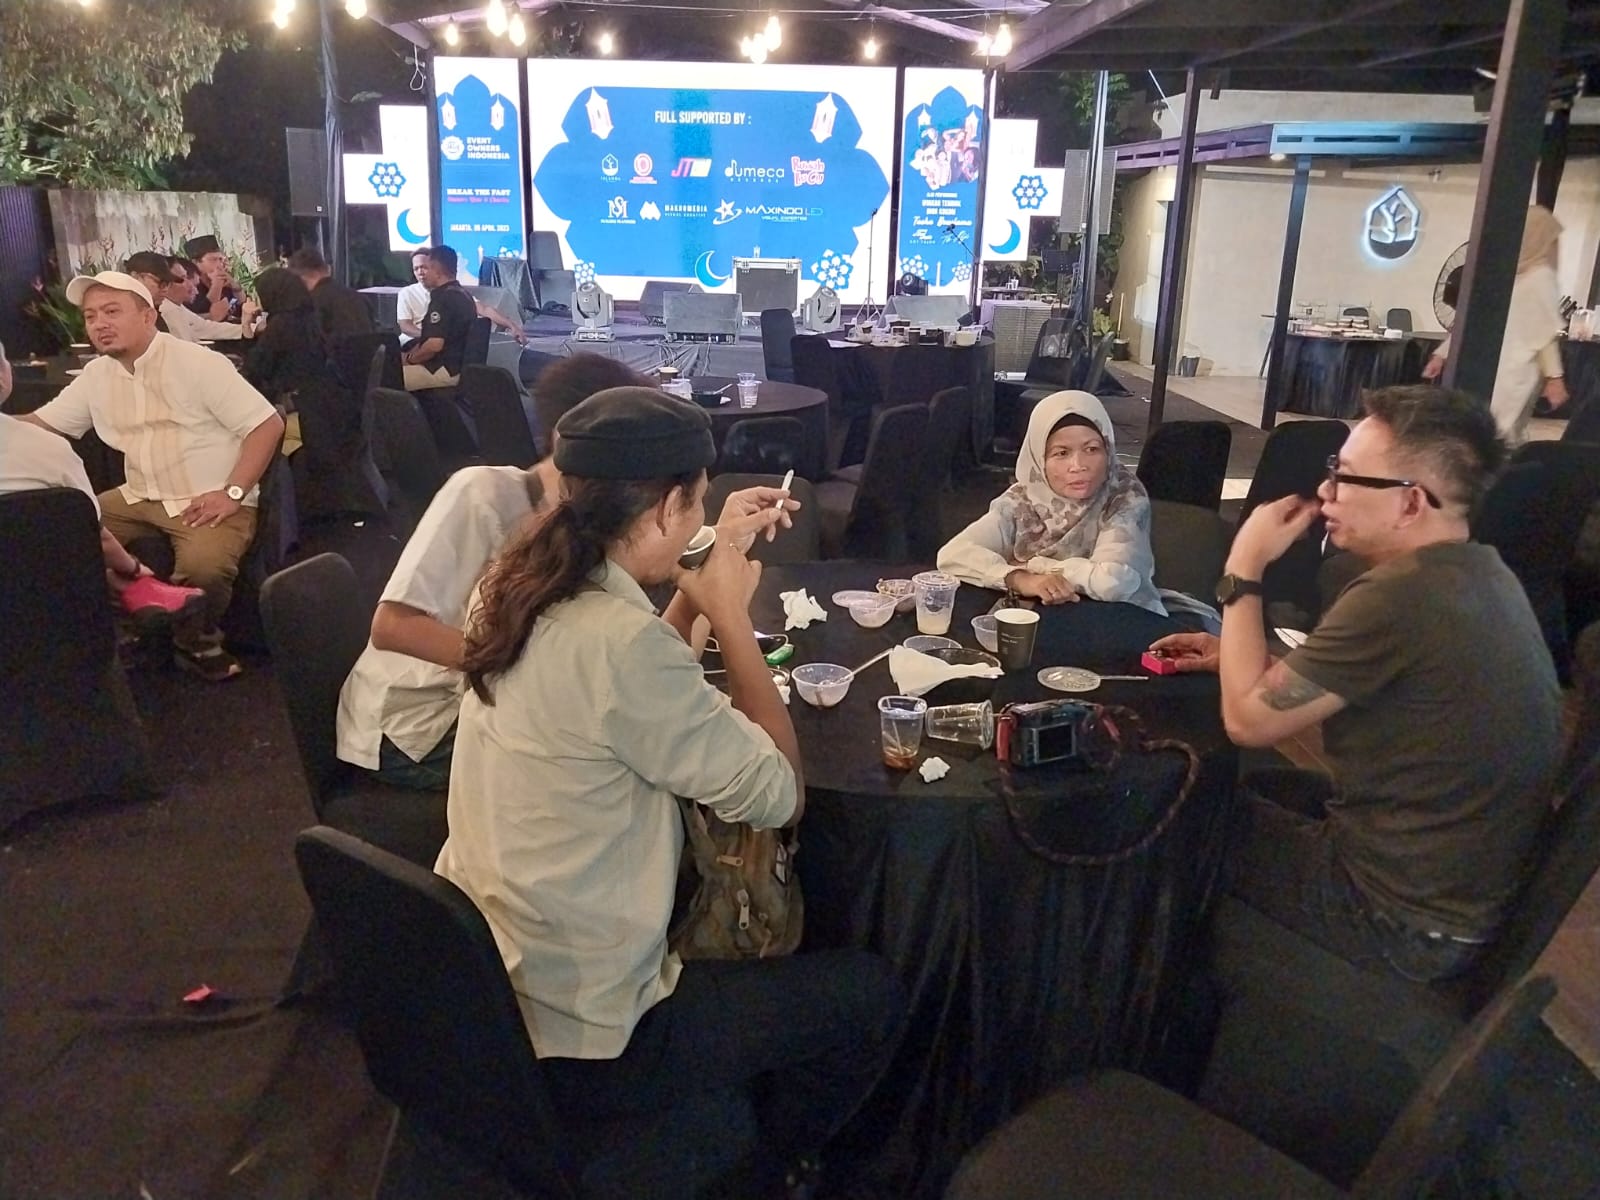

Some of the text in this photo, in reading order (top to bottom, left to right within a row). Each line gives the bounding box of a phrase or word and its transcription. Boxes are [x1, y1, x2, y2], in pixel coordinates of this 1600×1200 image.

[654, 110, 677, 123] FULL
[678, 111, 731, 124] SUPPORTED
[733, 112, 746, 125] BY
[466, 136, 492, 145] EVENT
[466, 144, 500, 152] OWNERS
[467, 152, 511, 160] INDONESIA
[447, 188, 511, 196] BREAK THE FAST
[745, 204, 804, 215] MAXINDO
